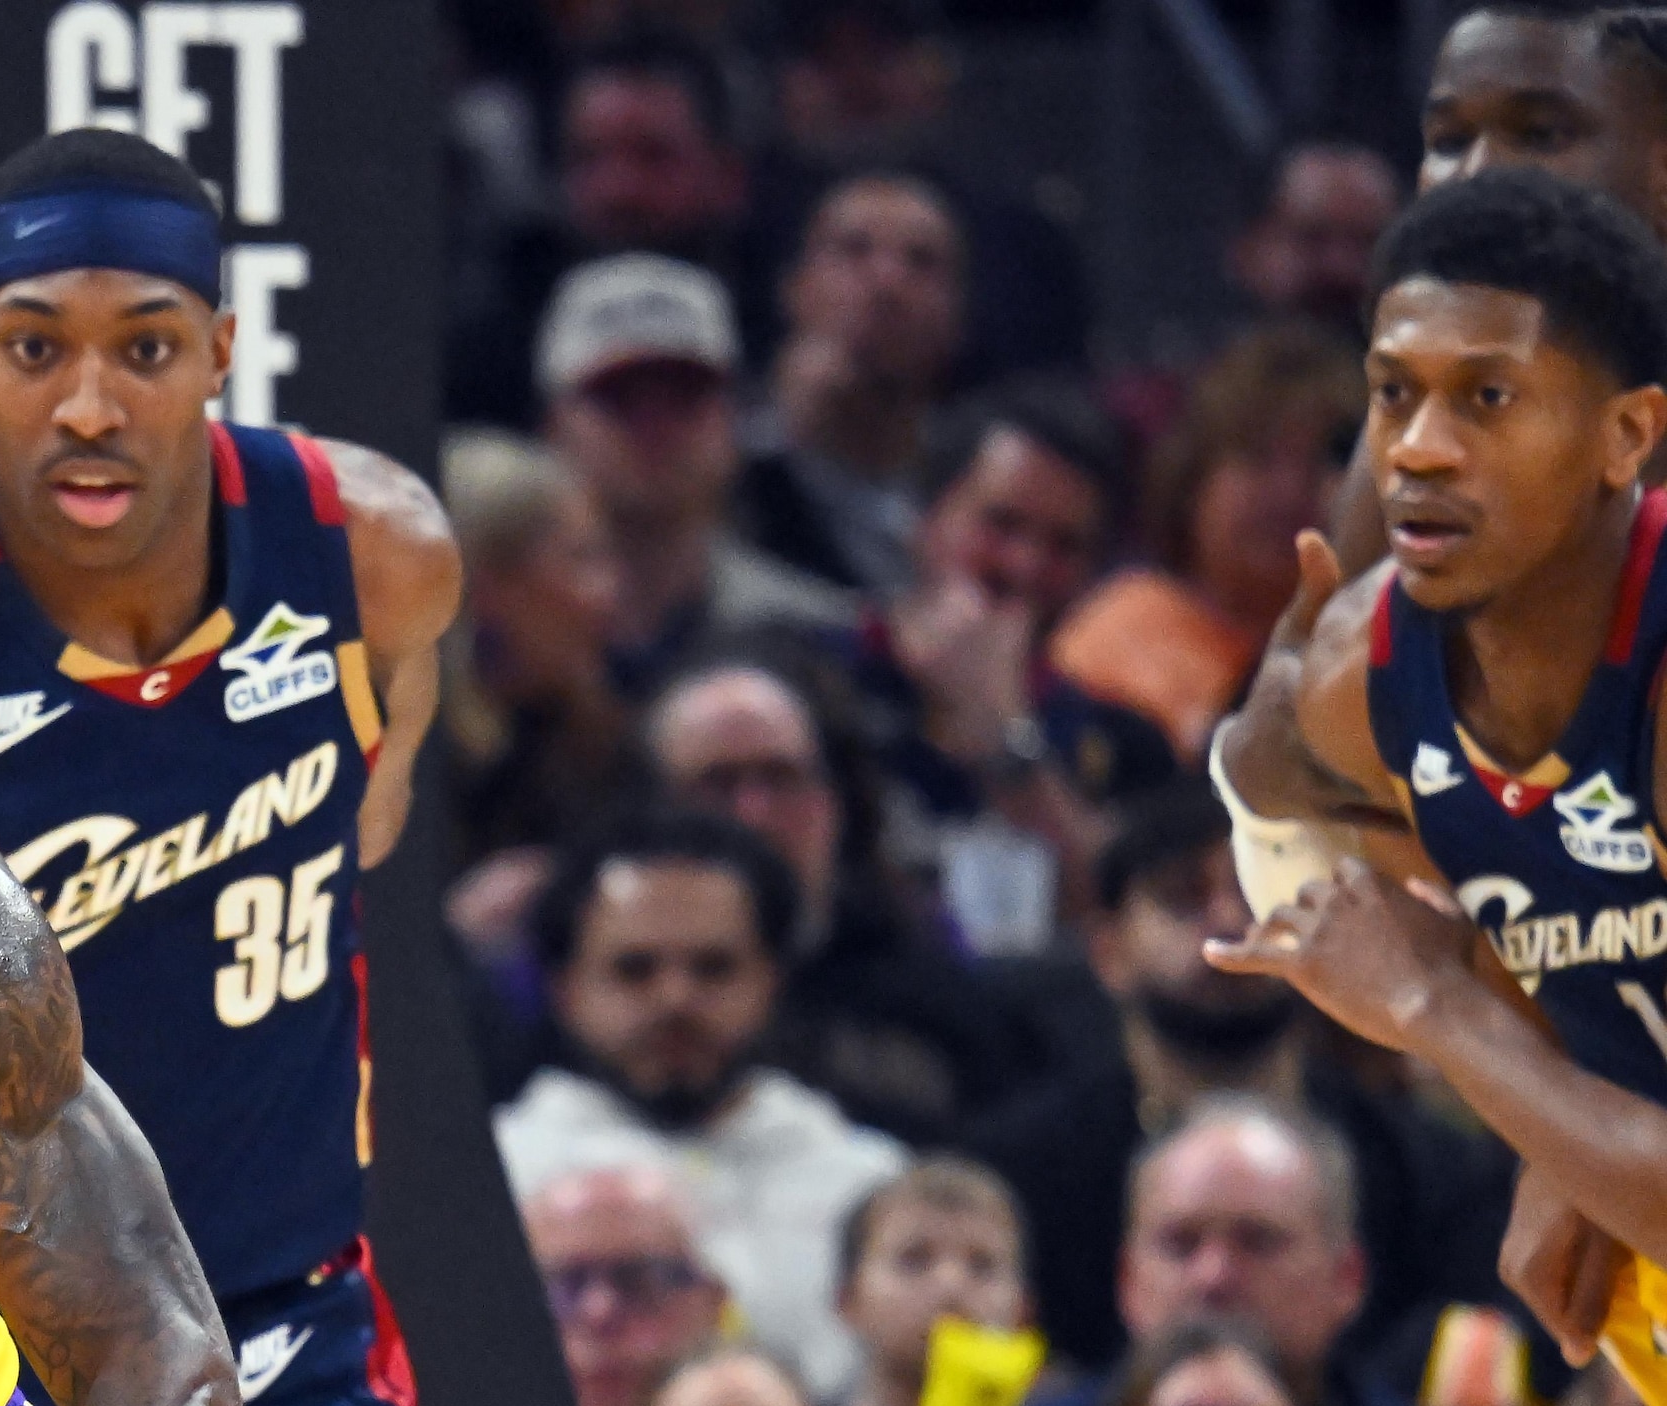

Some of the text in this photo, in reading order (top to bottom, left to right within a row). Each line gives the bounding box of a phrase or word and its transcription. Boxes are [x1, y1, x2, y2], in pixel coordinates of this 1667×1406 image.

[46, 2, 304, 225] GET
[140, 670, 170, 701] C
[230, 663, 330, 712] CLIFFS
[214, 844, 345, 1028] 35
